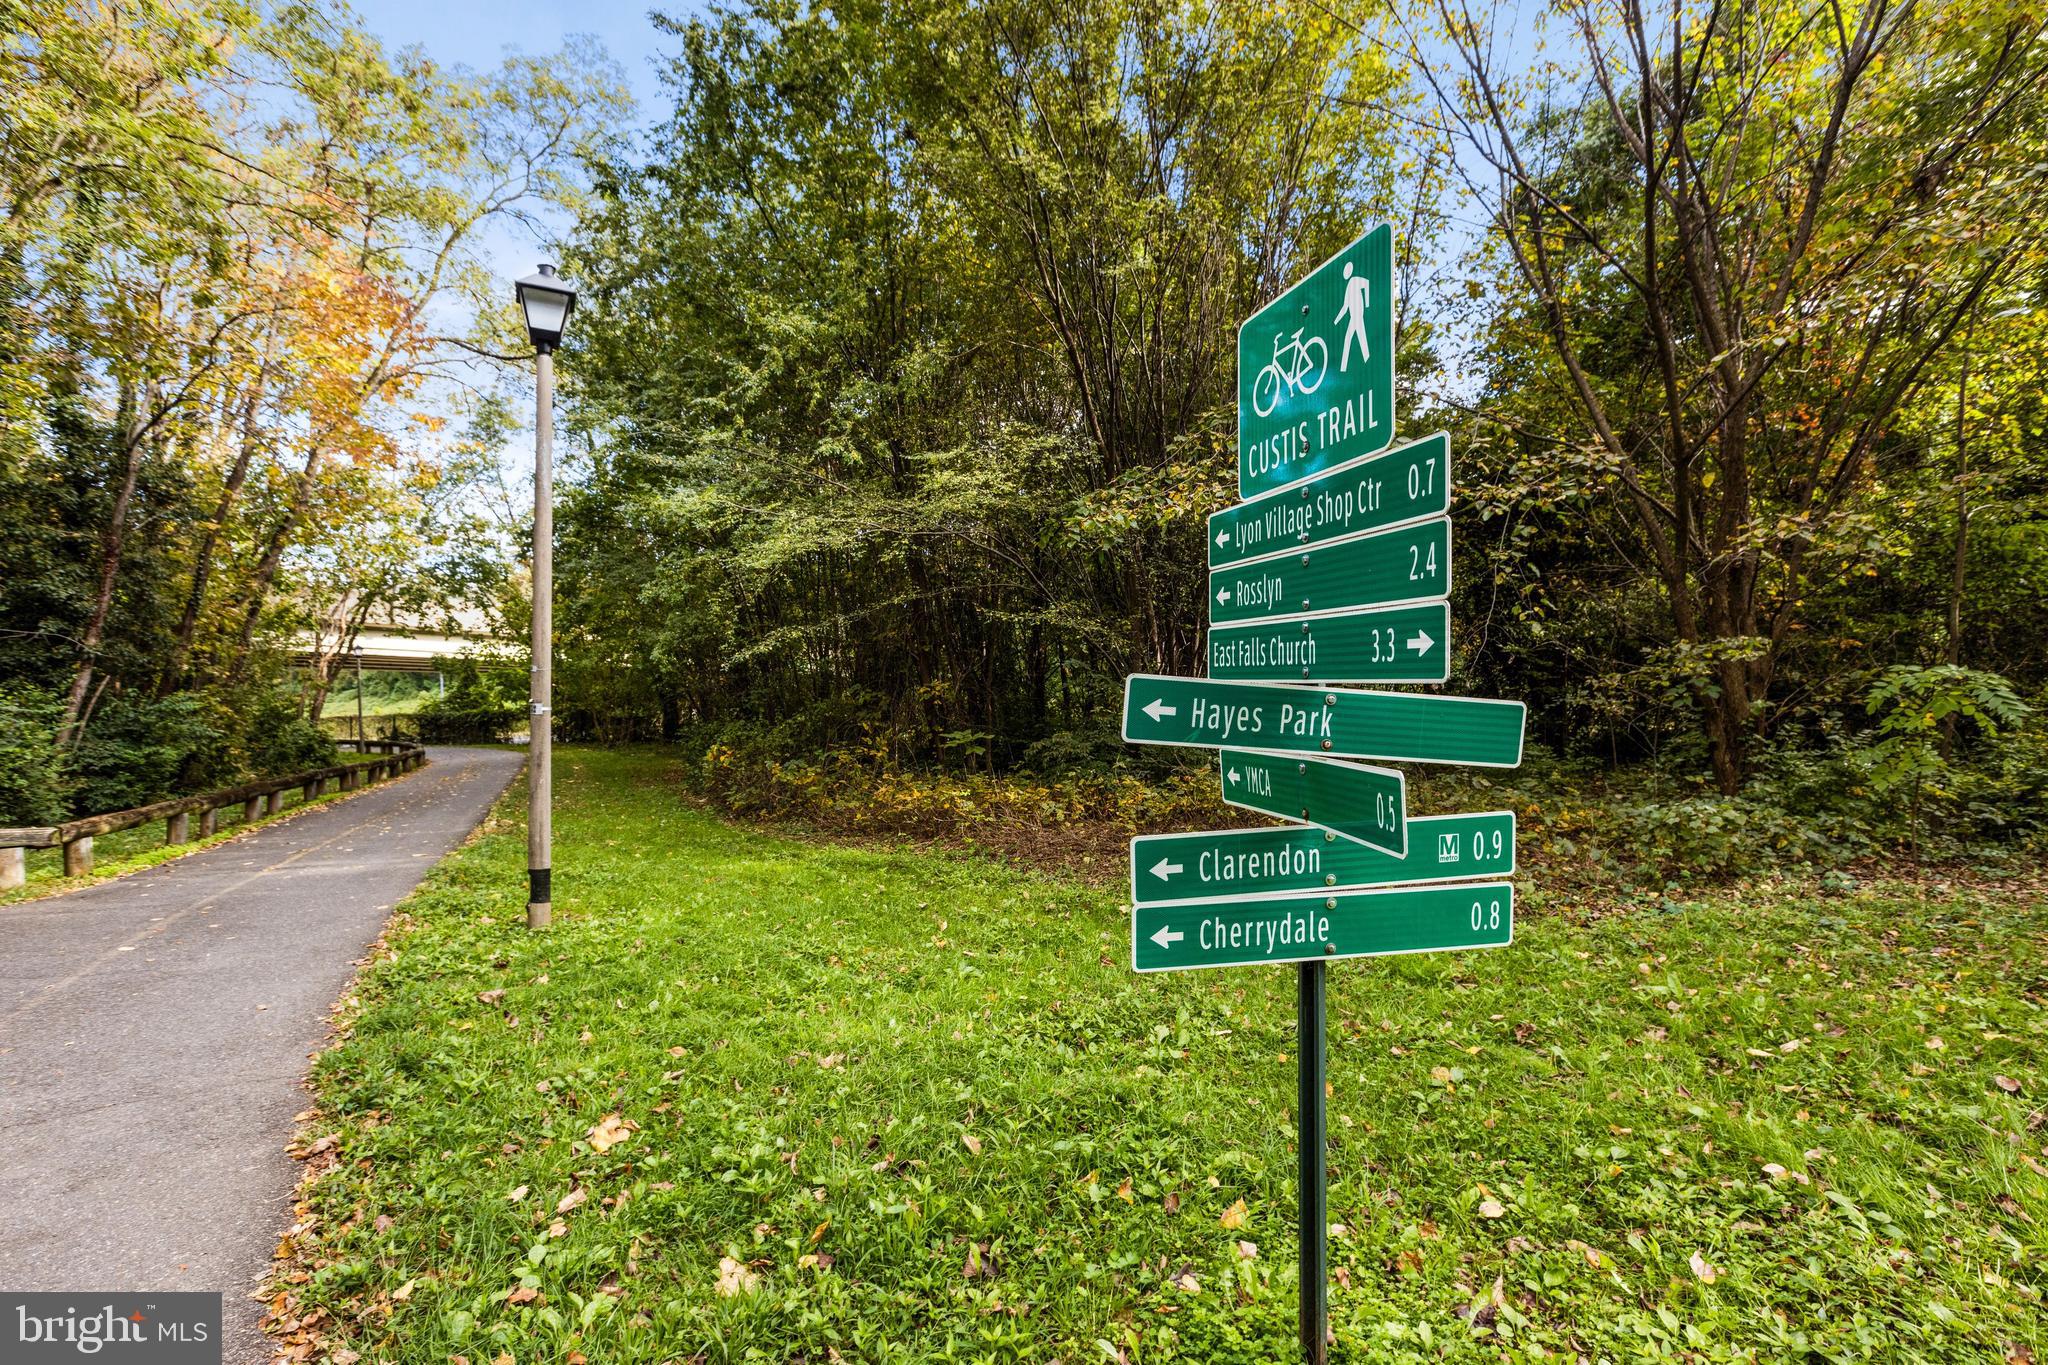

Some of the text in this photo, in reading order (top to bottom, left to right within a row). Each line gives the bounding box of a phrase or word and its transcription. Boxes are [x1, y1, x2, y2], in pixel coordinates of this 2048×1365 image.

[1248, 388, 1379, 479] CUSTIS TRAIL
[1235, 457, 1437, 554] Lyon Village Shop Ctr 0.7
[1236, 541, 1437, 611] Rosslyn 2.4
[1213, 627, 1396, 668] East Falls Church 3.3
[1190, 697, 1334, 740] Hayes Park
[1244, 765, 1396, 833] YMCA 0.5
[1198, 829, 1503, 883] Clarendon 0.9
[1198, 900, 1501, 954] Cherrydale 0.8
